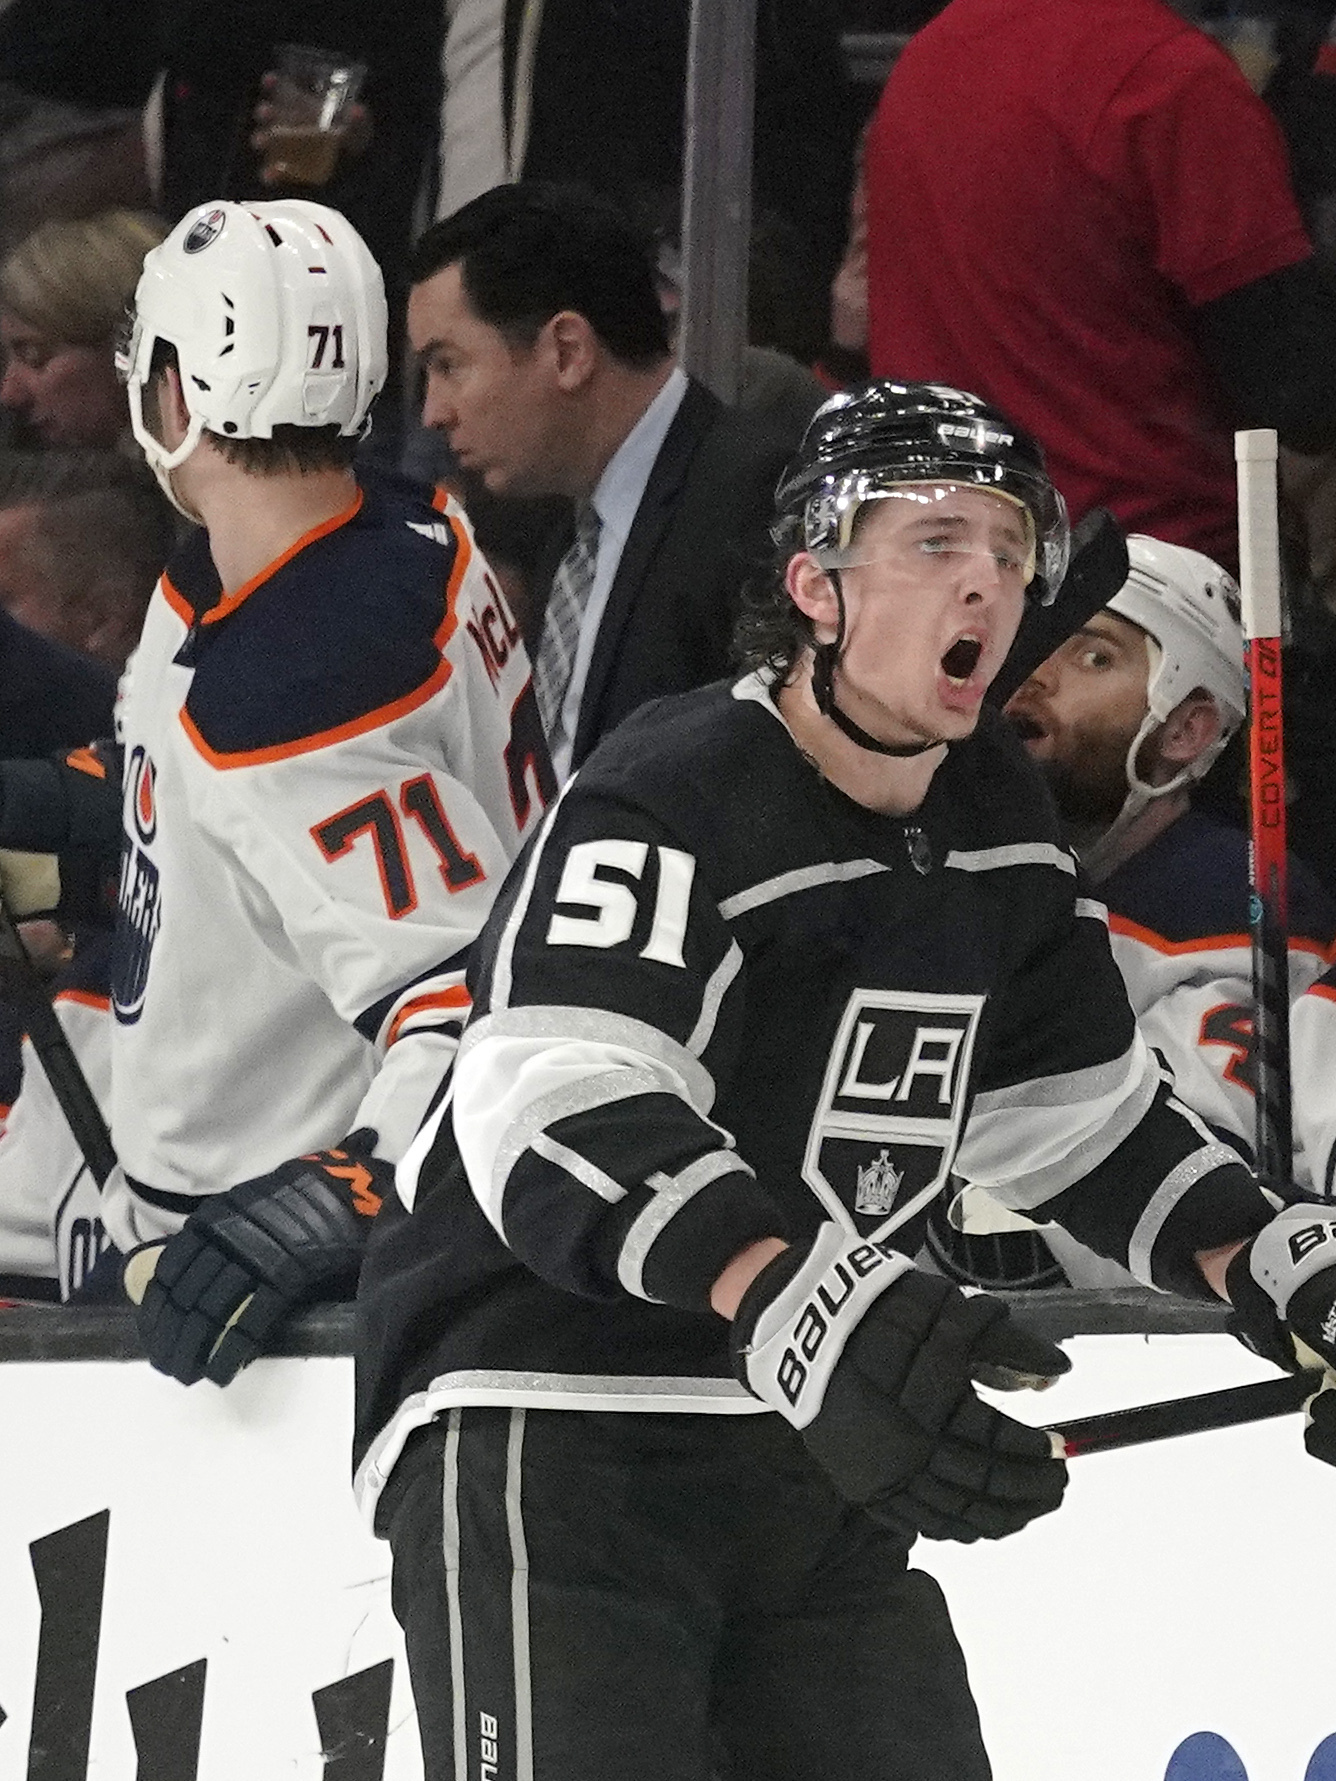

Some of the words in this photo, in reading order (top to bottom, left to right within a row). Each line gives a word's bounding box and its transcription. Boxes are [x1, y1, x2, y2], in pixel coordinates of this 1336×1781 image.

[308, 325, 345, 369] 71
[1258, 688, 1281, 829] COVERT
[310, 772, 487, 920] 71
[546, 838, 697, 969] 51
[836, 1020, 965, 1105] LA
